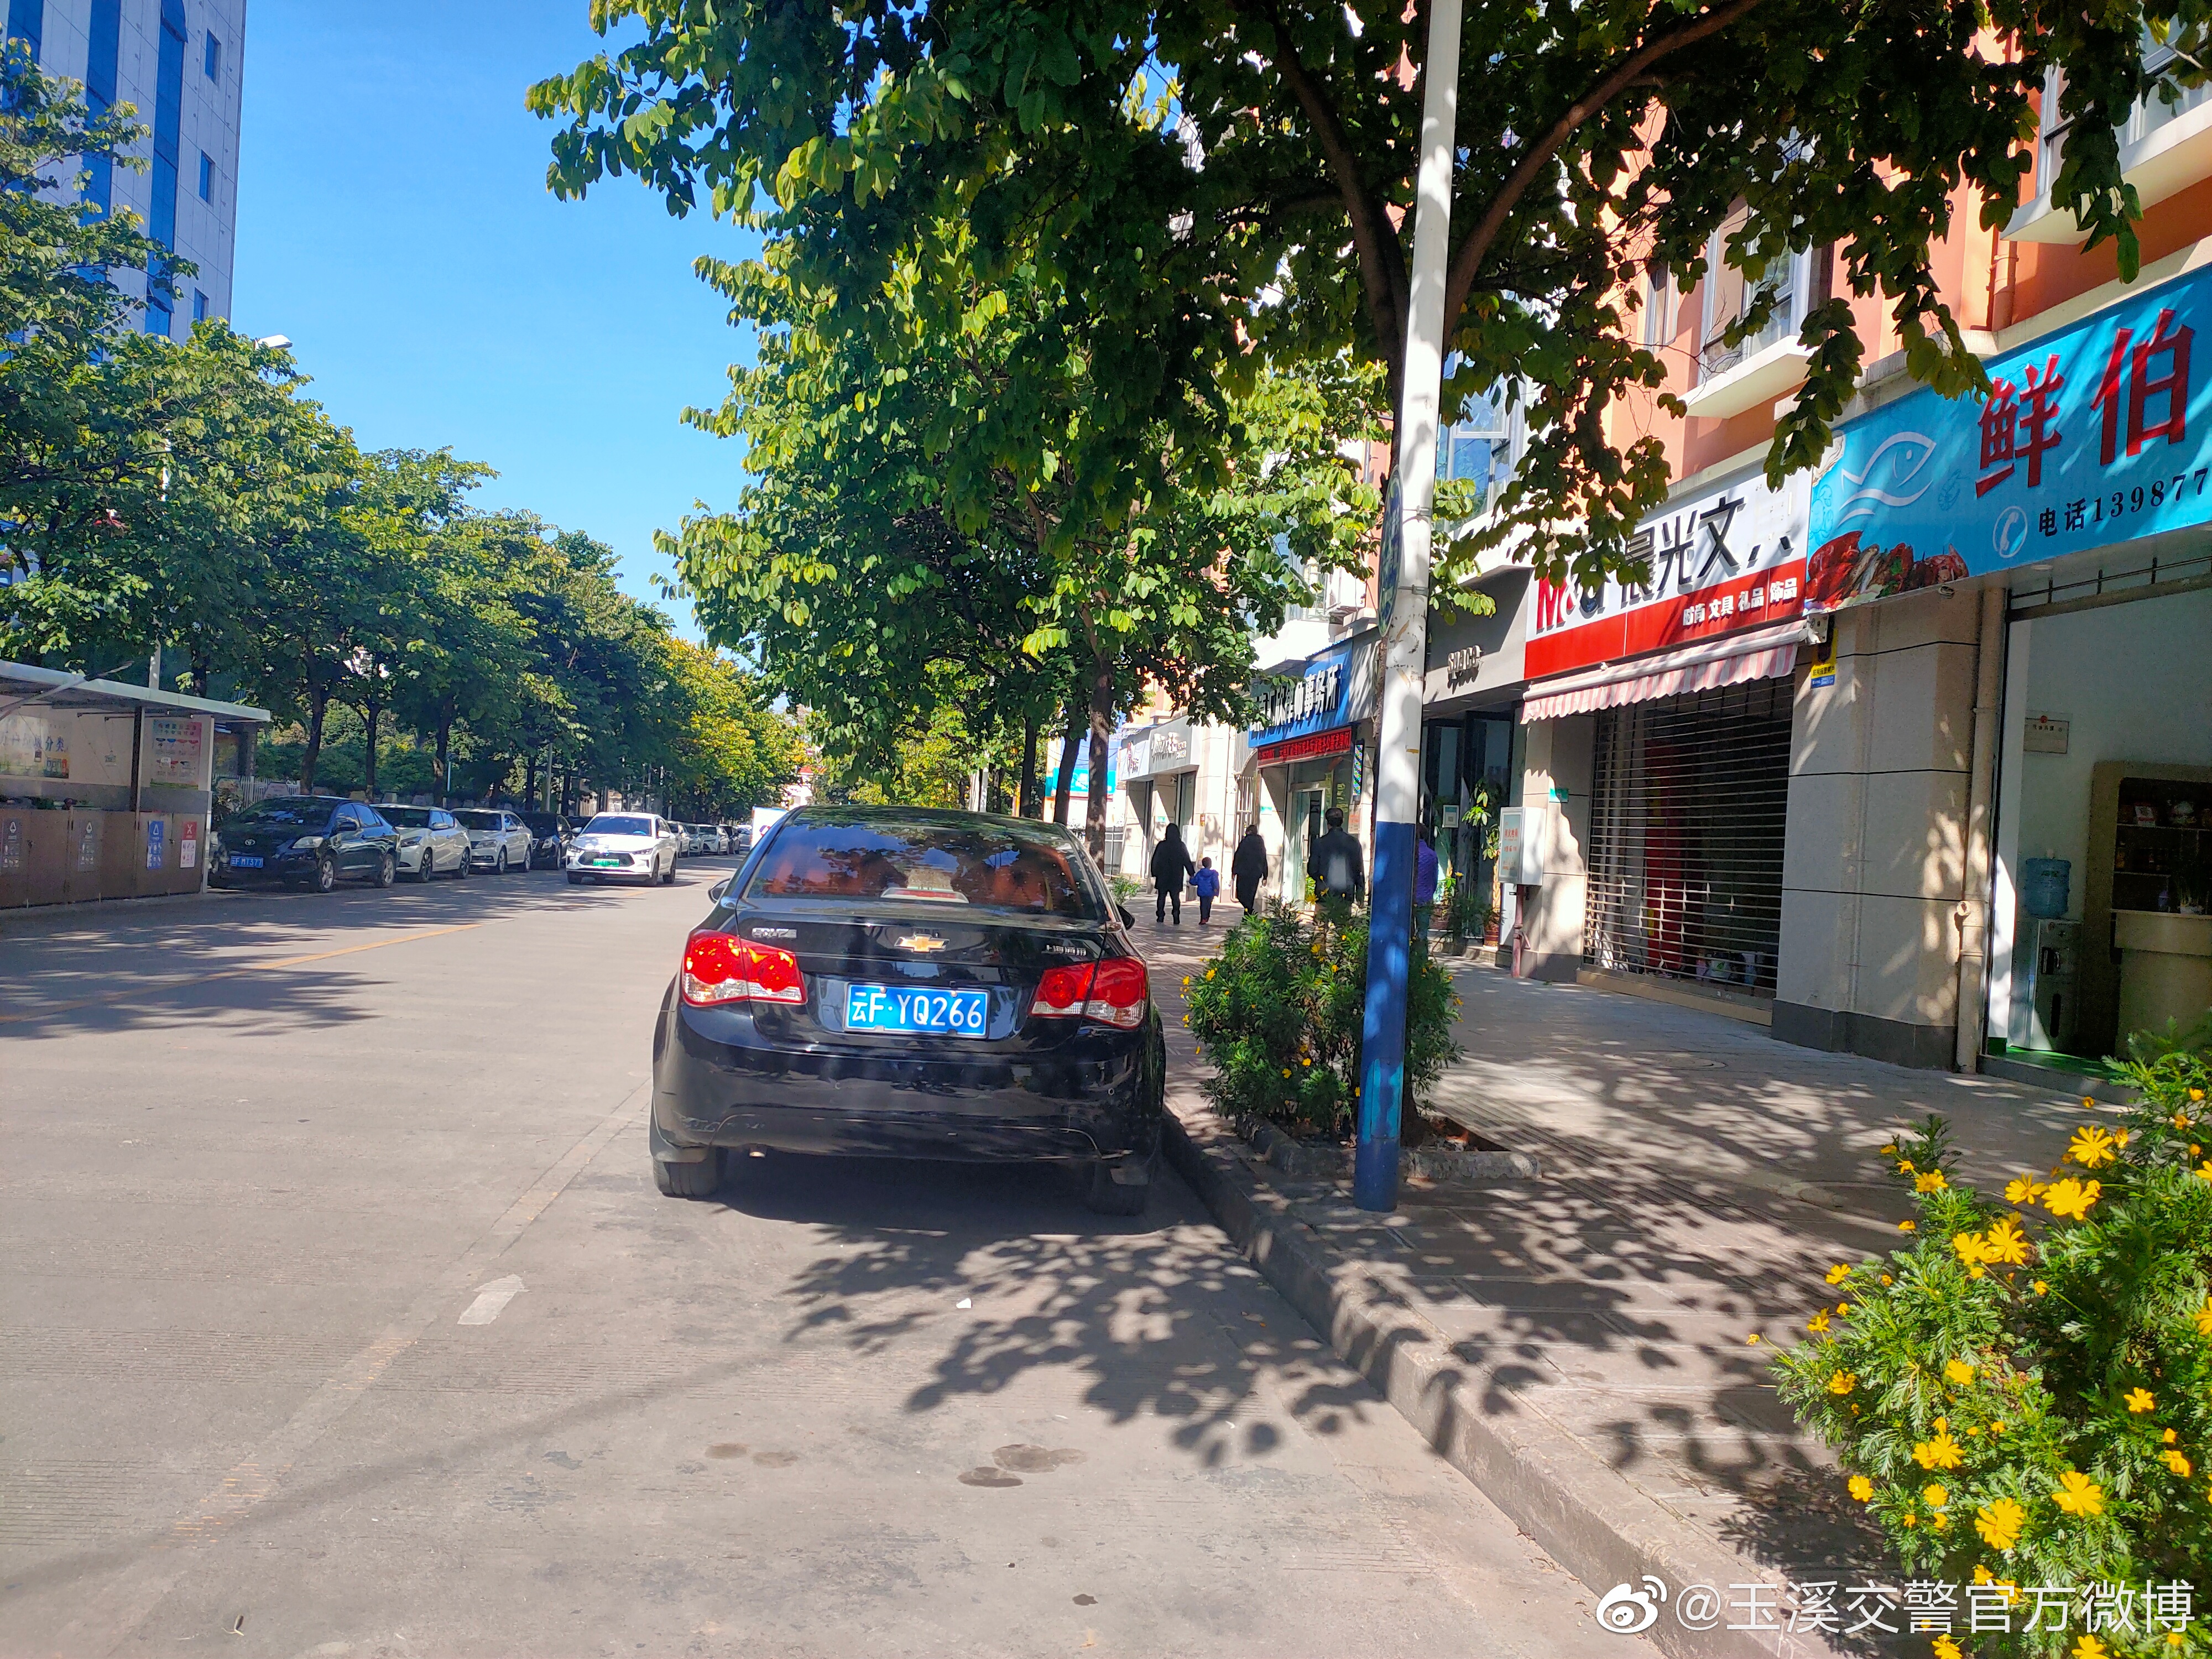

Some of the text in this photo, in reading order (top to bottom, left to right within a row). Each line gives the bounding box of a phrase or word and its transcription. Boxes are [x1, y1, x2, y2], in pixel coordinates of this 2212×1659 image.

[1976, 309, 2194, 498] 鲜伯
[1621, 496, 1792, 608] 晨光文
[1683, 577, 1797, 625] 时尚 文具 礼品 饰品
[852, 992, 982, 1028] 云F·YQ266
